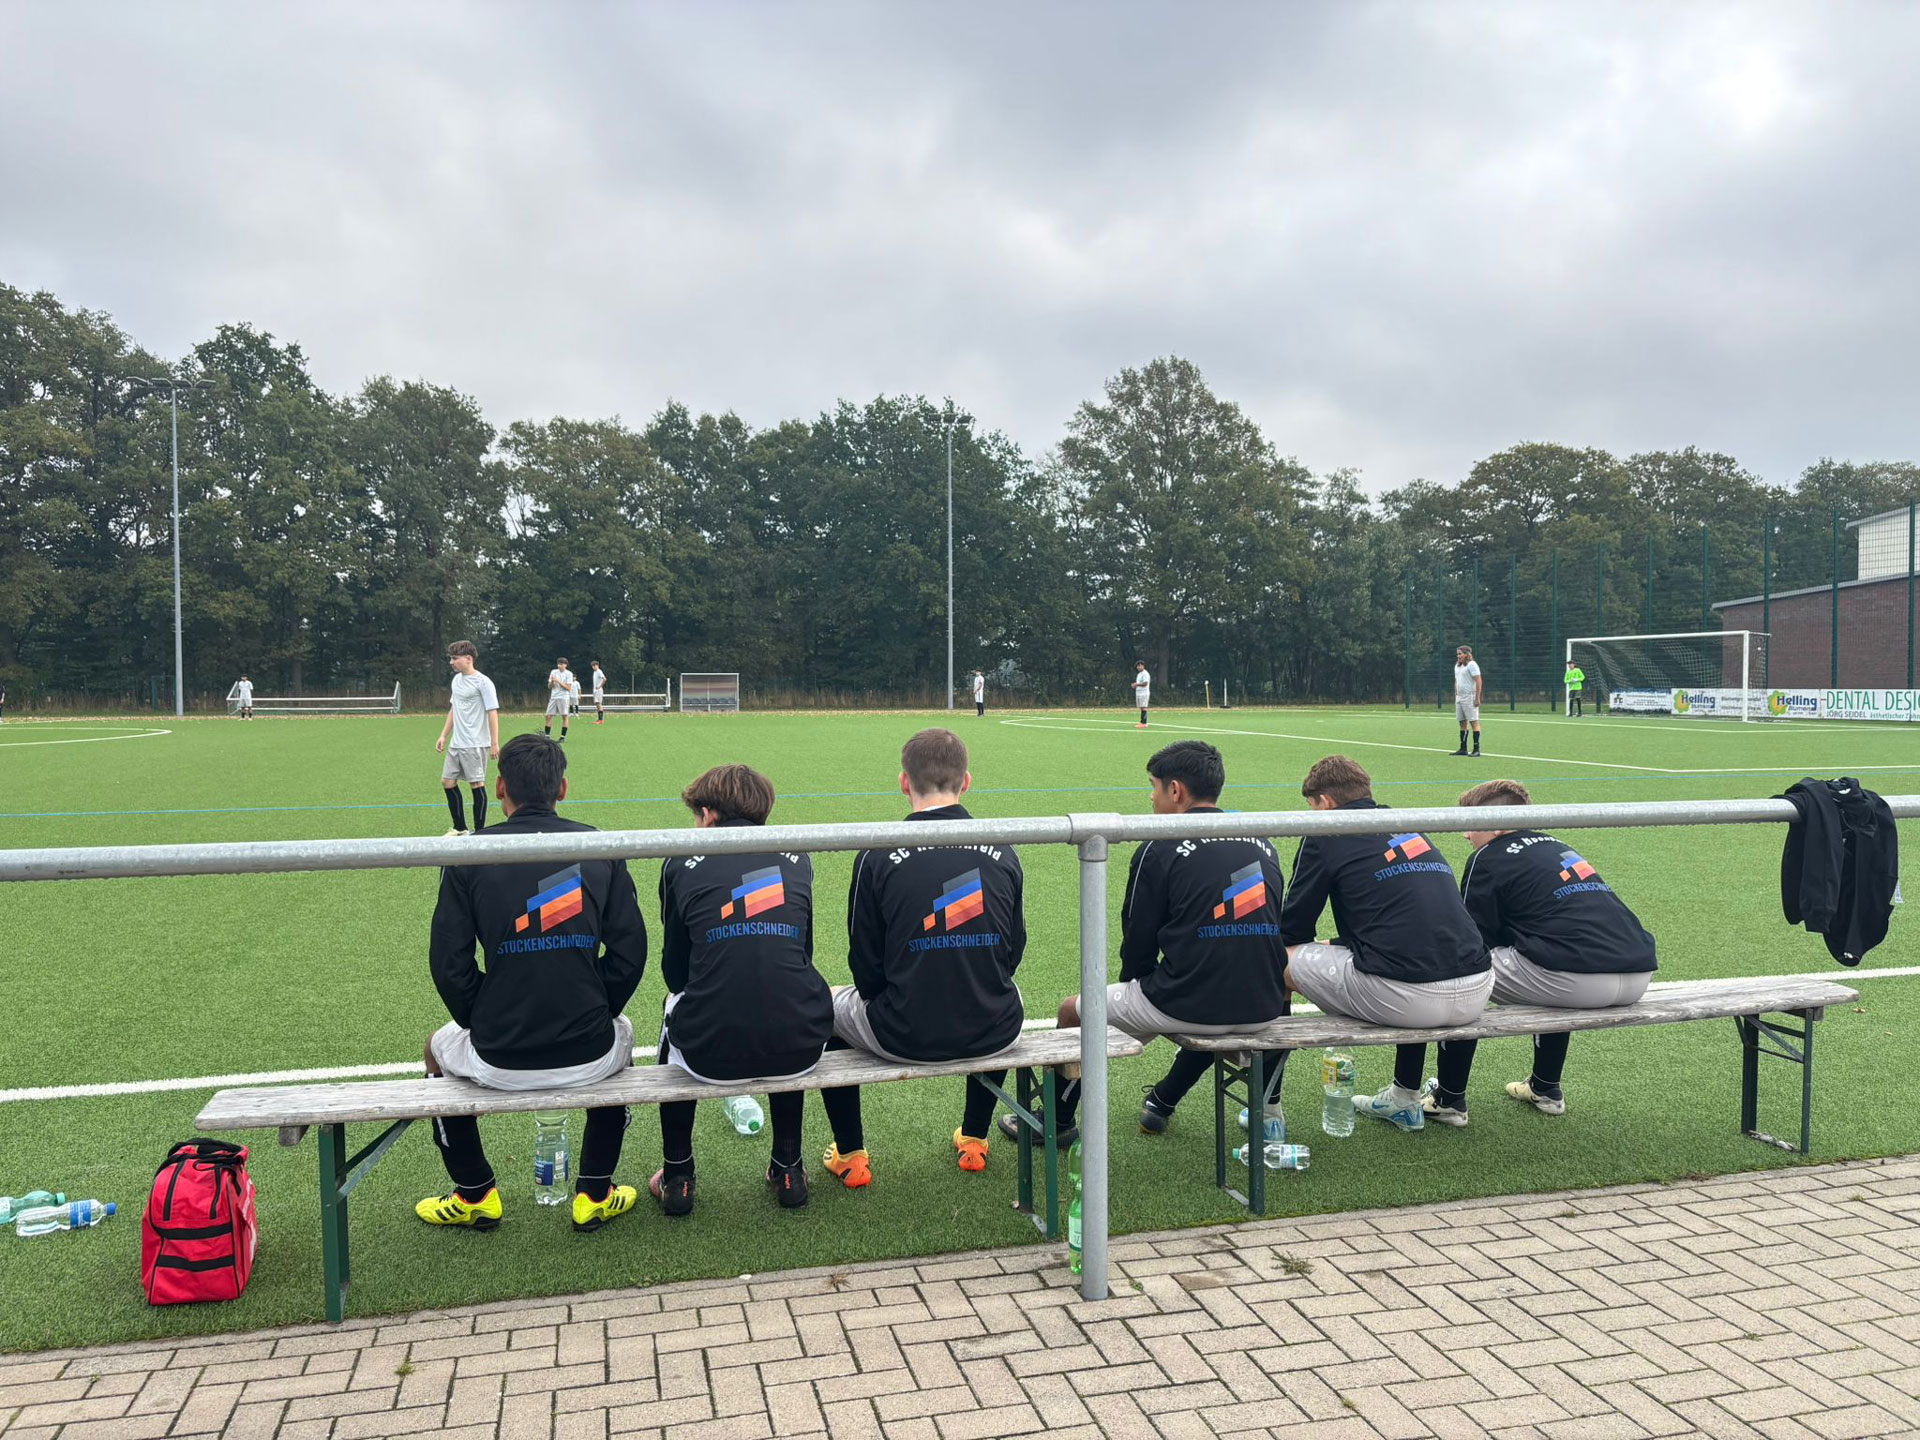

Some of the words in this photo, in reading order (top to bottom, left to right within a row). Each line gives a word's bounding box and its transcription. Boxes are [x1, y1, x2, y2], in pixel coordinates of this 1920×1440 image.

[1681, 694, 1716, 709] Helling
[1776, 695, 1817, 711] Helling
[1826, 690, 1879, 710] DENTAL
[1885, 690, 1920, 711] DESI
[889, 847, 911, 864] SC
[1176, 839, 1197, 857] SC
[1506, 842, 1524, 854] SC
